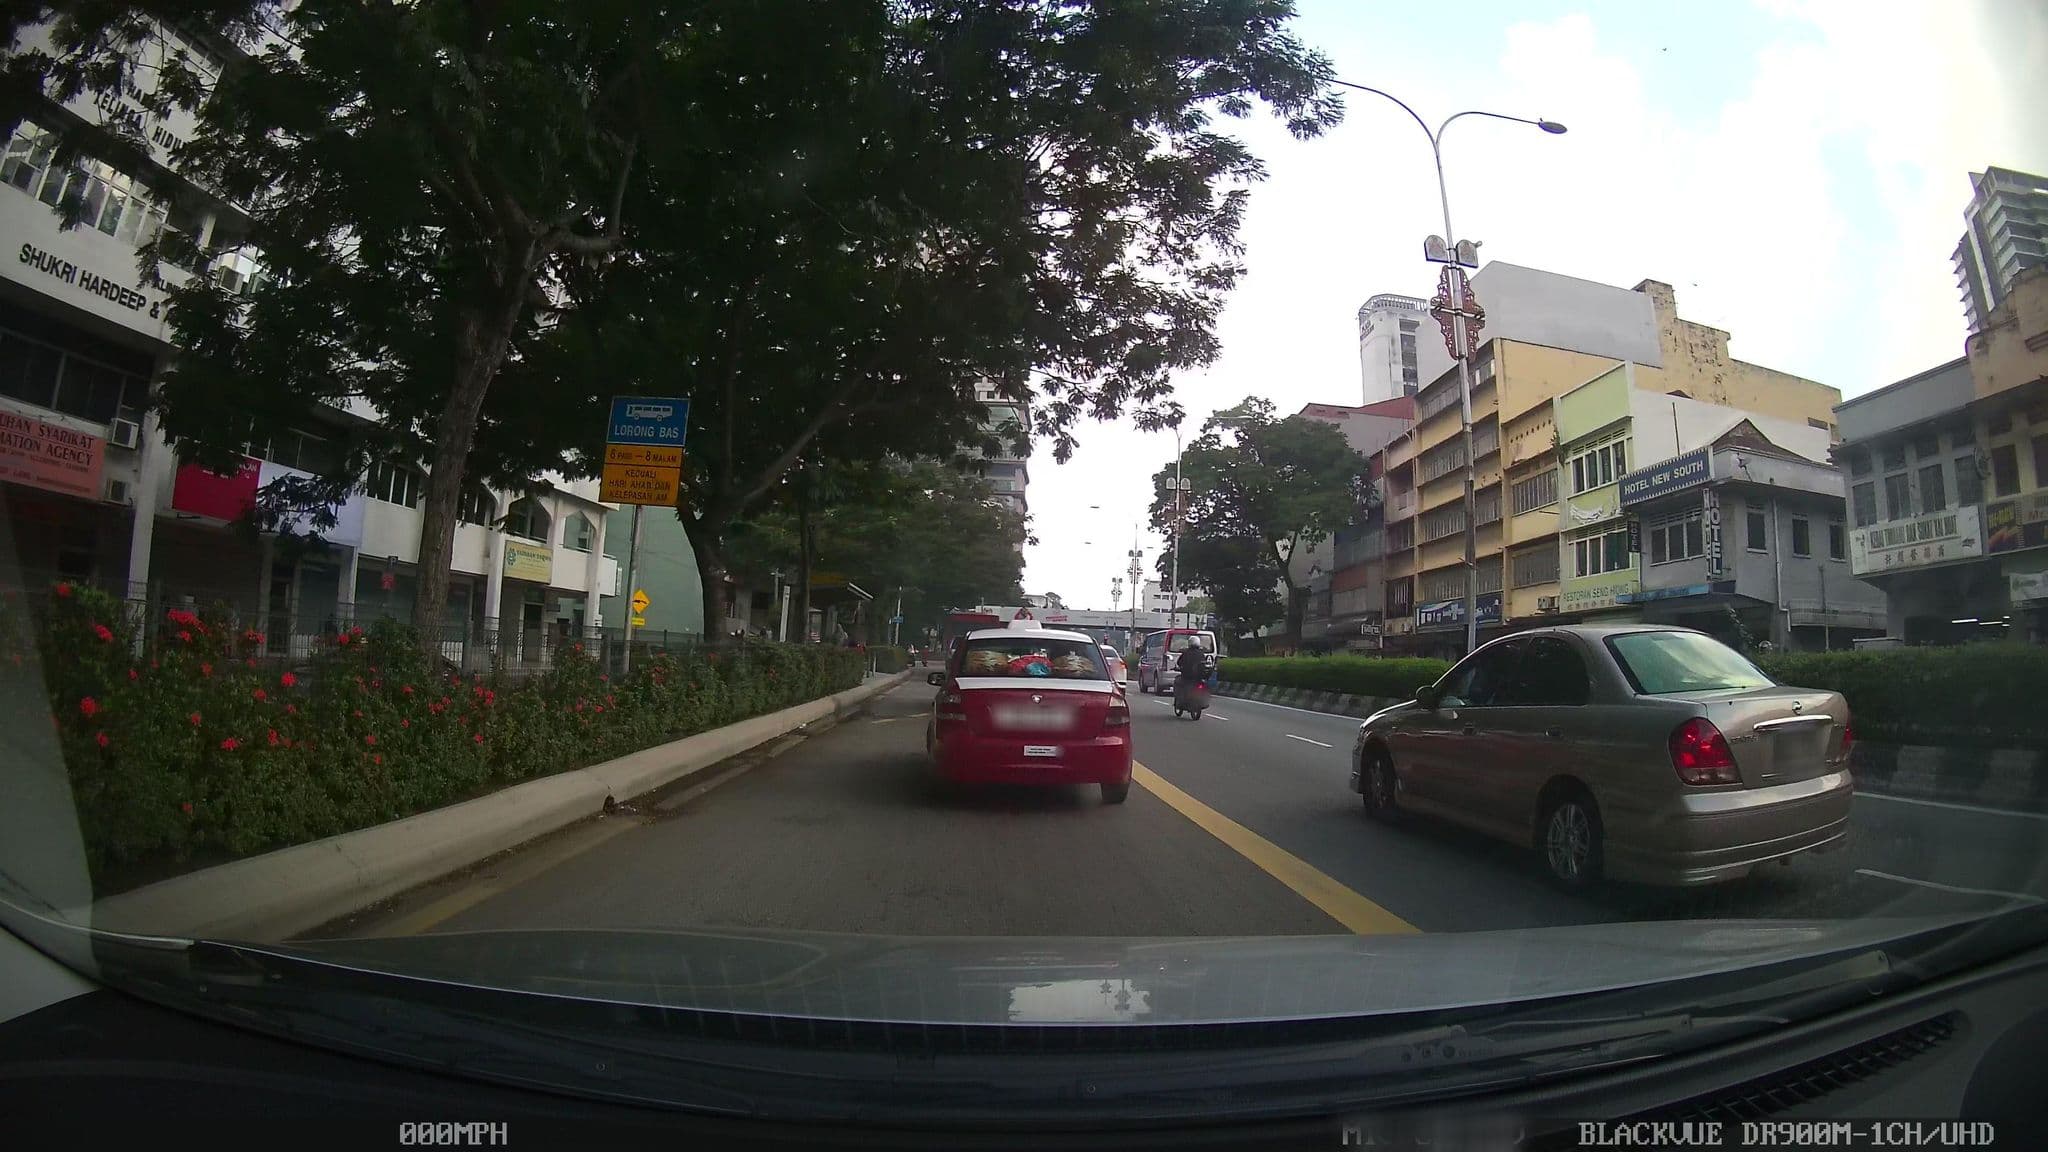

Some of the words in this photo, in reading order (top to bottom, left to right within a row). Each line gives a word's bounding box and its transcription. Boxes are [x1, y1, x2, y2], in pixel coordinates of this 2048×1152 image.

[152, 126, 182, 151] HIDU
[19, 243, 78, 284] SHUKRI
[79, 270, 147, 311] HARDEEP
[149, 301, 160, 319] &
[39, 424, 94, 450] SYARIKAT
[614, 424, 655, 437] LORONG
[659, 426, 679, 439] BAS
[47, 443, 94, 466] AGENCY
[645, 450, 651, 461] 8
[653, 453, 677, 462] MALAM
[624, 469, 657, 479] KECUALI
[1624, 479, 1650, 495] HOTEL
[1652, 471, 1671, 486] NEW
[1673, 460, 1704, 479] SOUTH
[1710, 491, 1721, 576] HOTEL
